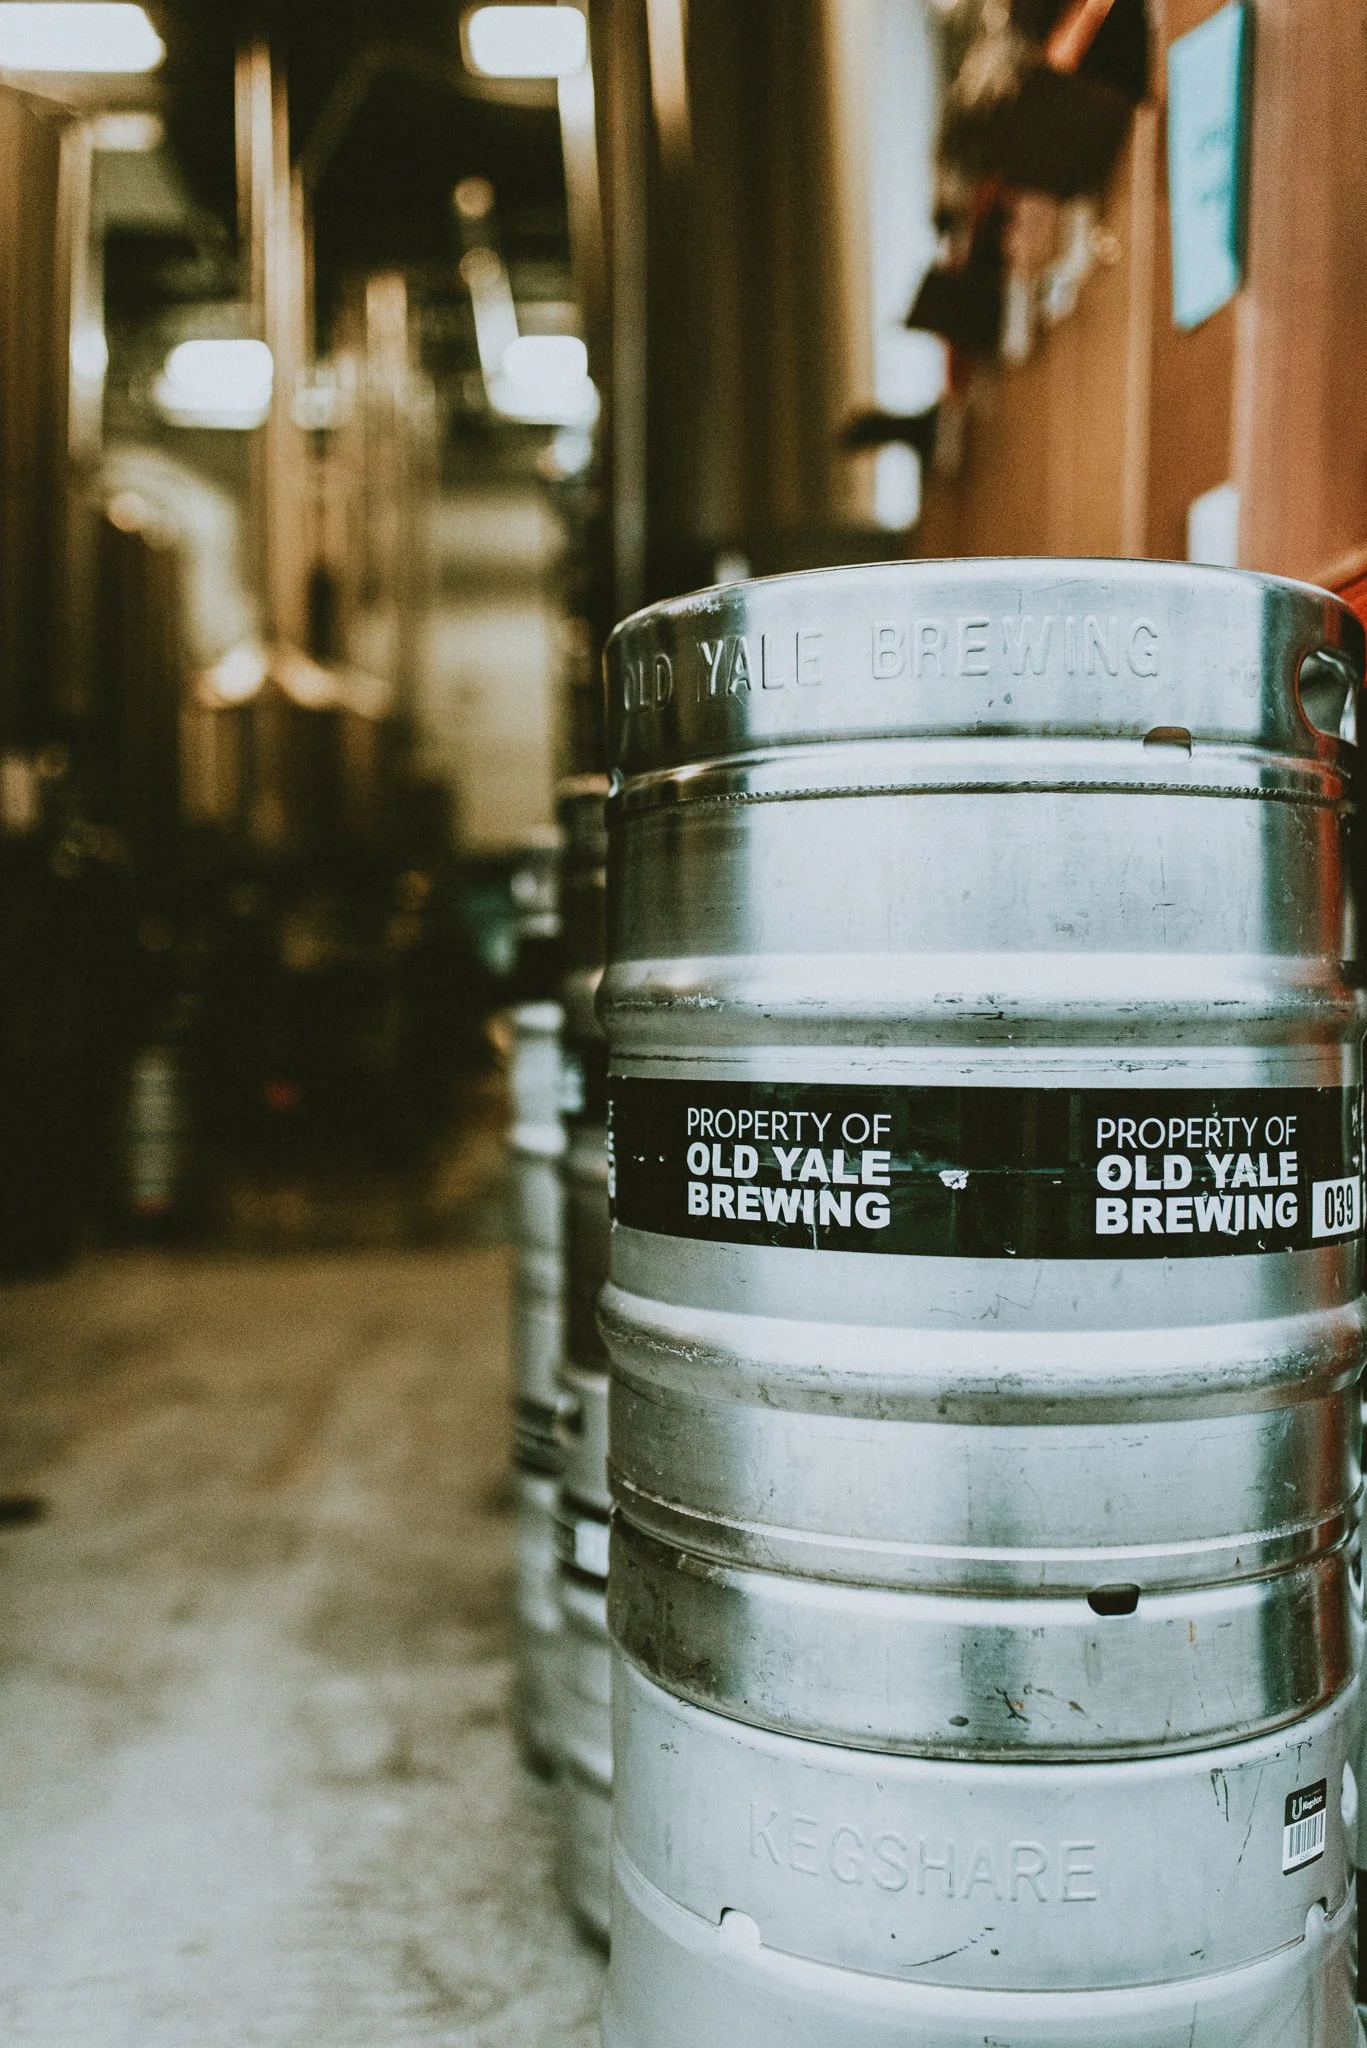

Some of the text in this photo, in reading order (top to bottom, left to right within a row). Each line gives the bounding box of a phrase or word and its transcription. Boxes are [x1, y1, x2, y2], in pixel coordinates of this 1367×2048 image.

[698, 631, 824, 701] YALE
[872, 614, 1159, 681] BREWING
[687, 1107, 892, 1144] PROPERTY OF
[1096, 1116, 1297, 1149] PROPERTY OF
[686, 1142, 891, 1186] OLD YALE
[1096, 1151, 1298, 1191] OLD YALE
[687, 1181, 891, 1229] BREWING
[1095, 1192, 1298, 1235] BREWING
[1324, 1184, 1354, 1229] 039
[748, 1800, 1098, 1902] KEGSHARE
